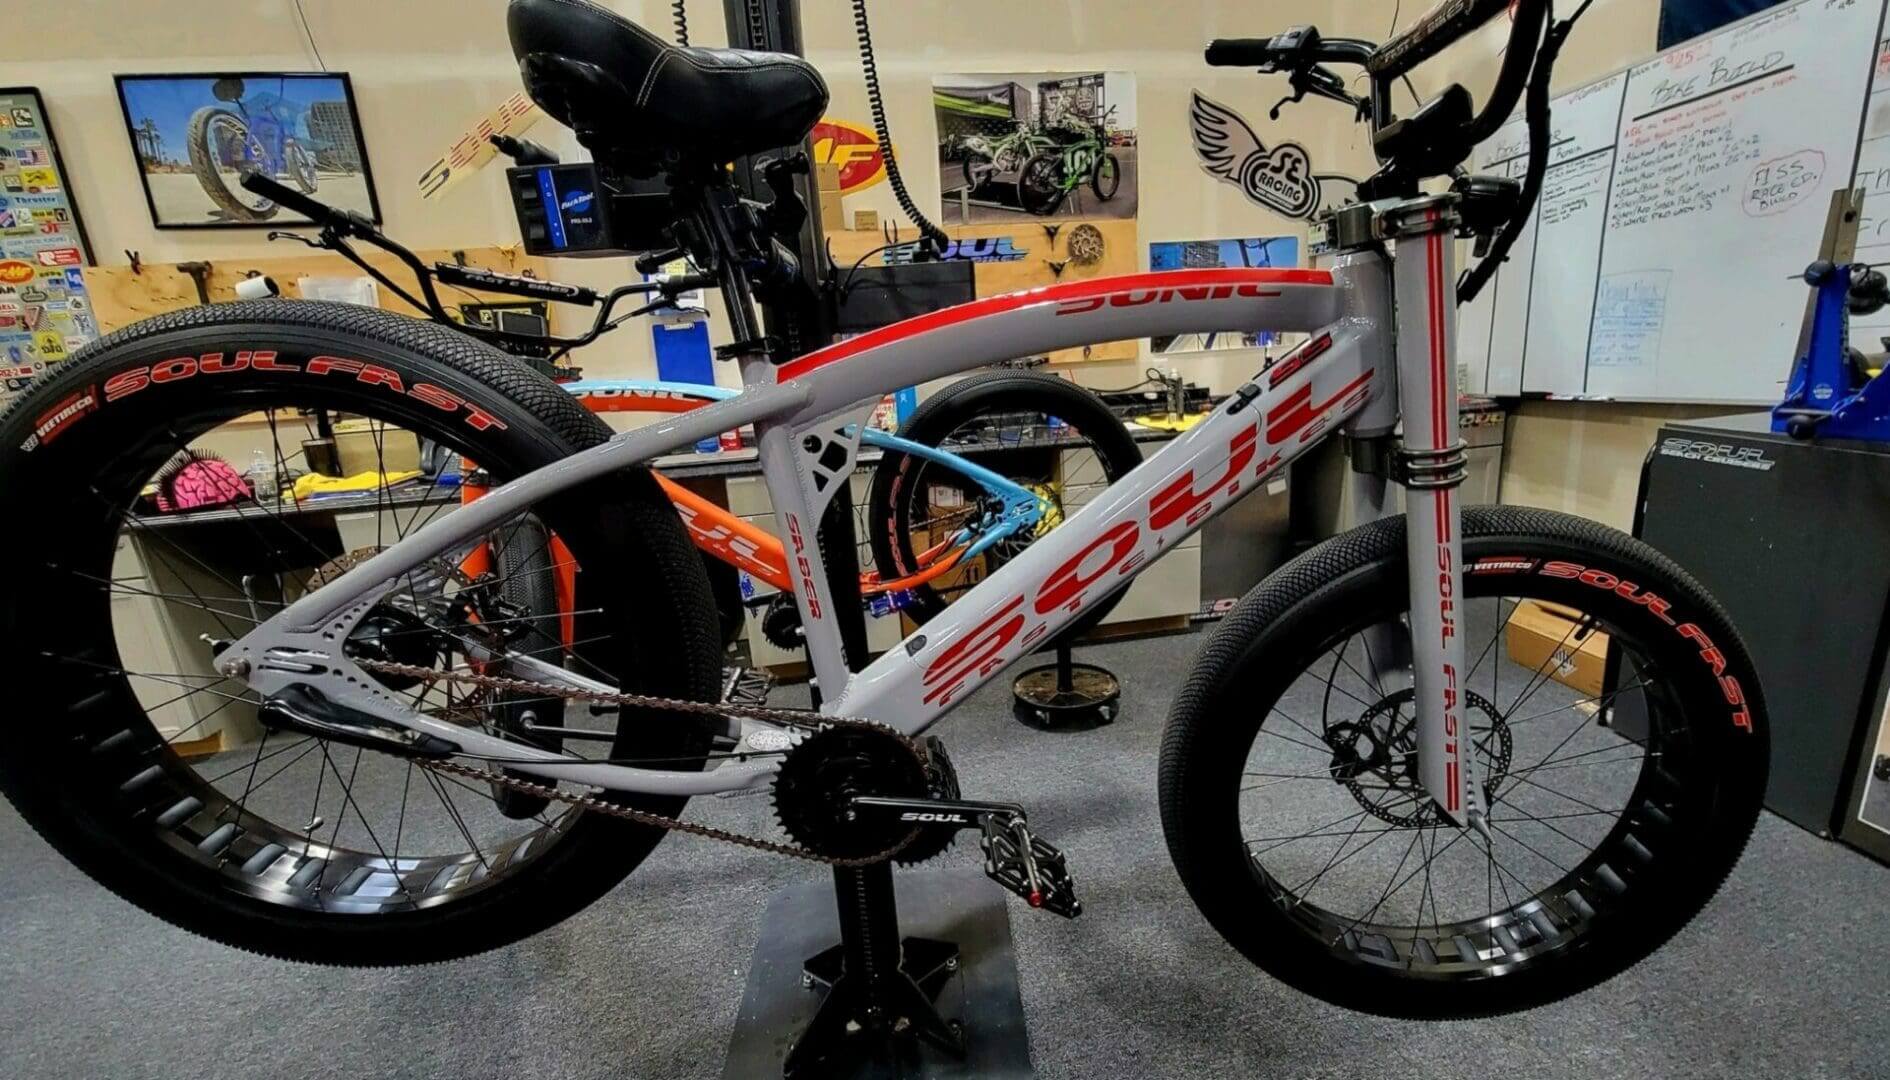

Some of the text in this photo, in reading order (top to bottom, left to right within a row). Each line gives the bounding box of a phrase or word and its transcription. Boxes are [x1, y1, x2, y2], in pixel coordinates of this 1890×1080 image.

[1258, 171, 1301, 201] RACING
[103, 351, 508, 433] SOUL FAST
[1661, 437, 1776, 465] SOUL
[922, 367, 1375, 706] SOUL
[1436, 545, 1458, 762] SOUL FAST
[1538, 561, 1753, 734] SOUL FAST
[900, 812, 968, 823] SOUL
